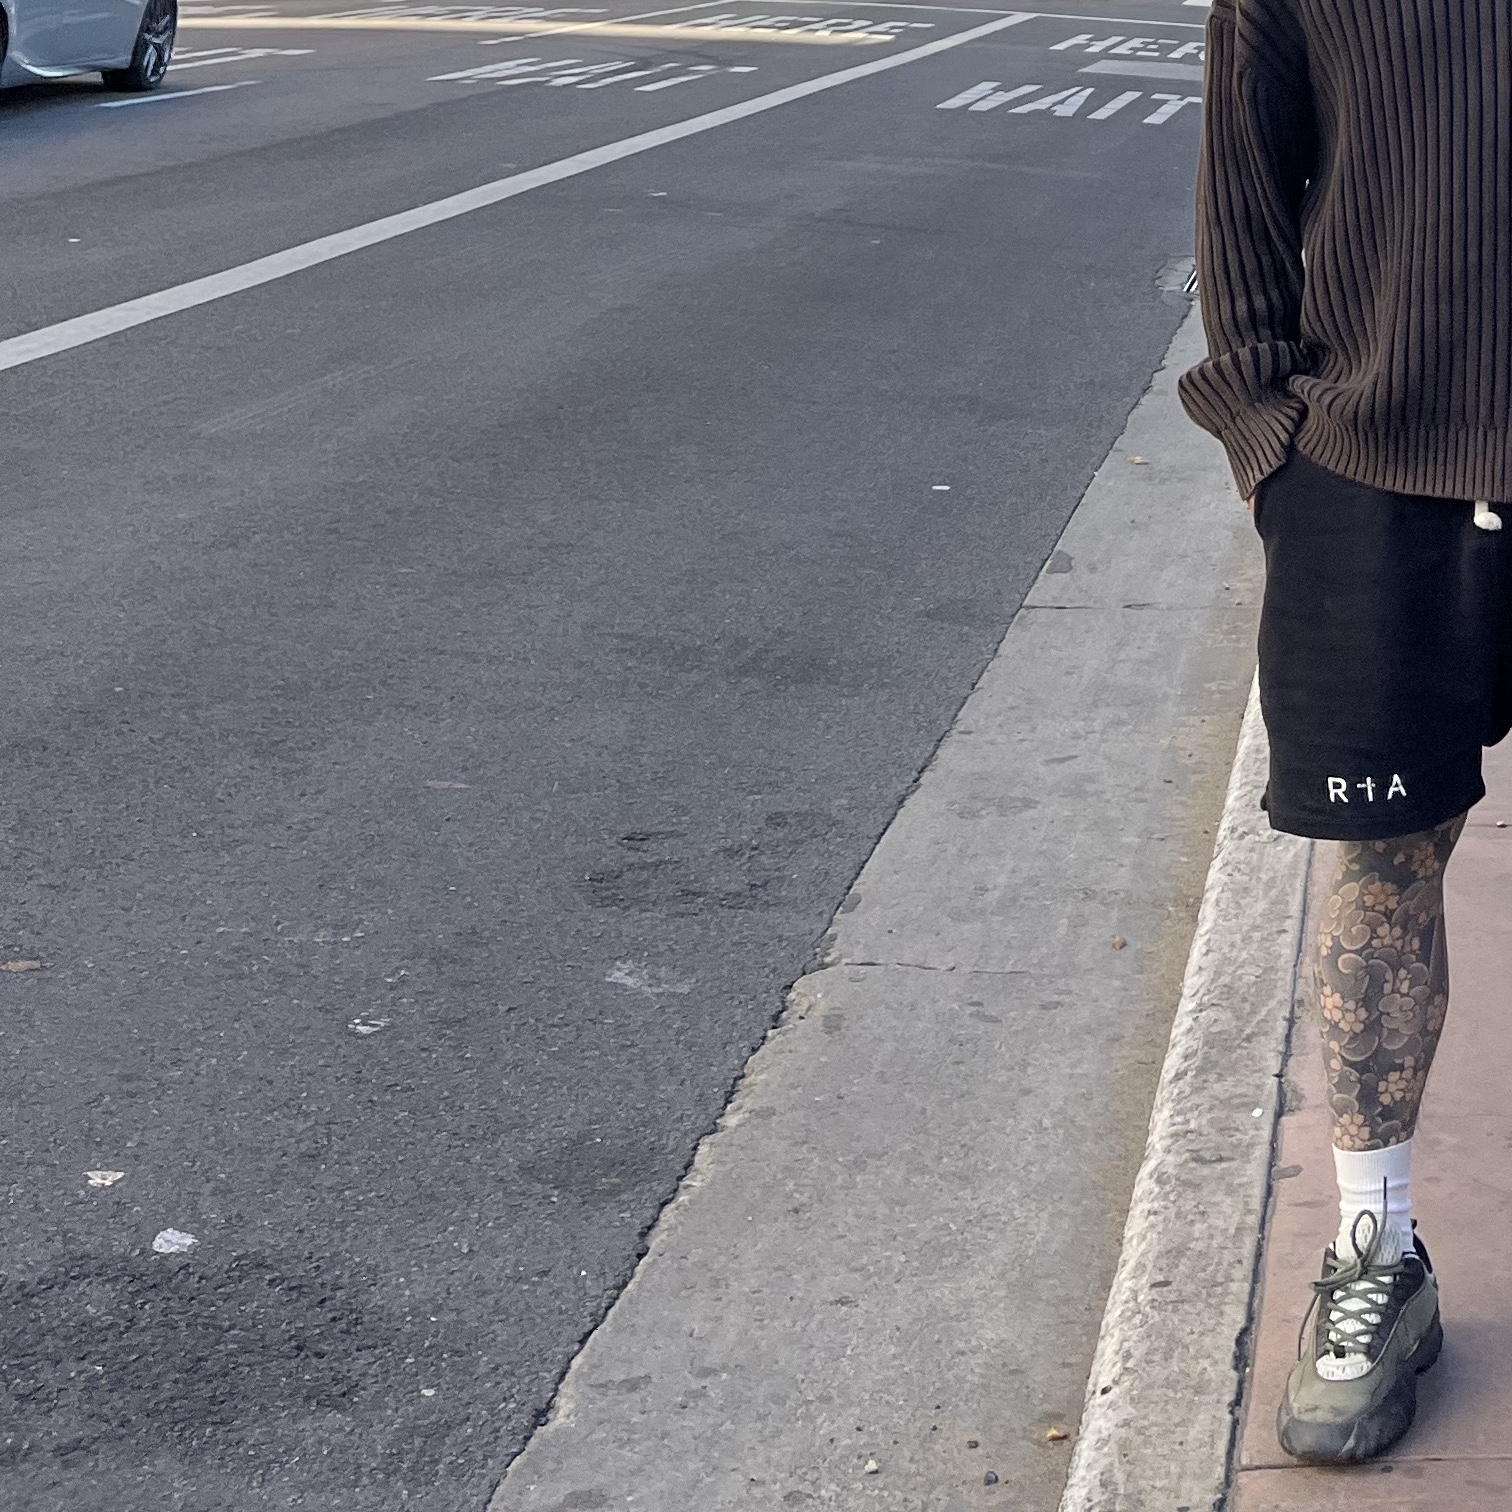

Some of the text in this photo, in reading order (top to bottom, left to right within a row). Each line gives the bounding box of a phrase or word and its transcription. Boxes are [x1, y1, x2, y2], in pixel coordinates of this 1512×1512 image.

[675, 13, 936, 39] HERE
[1048, 33, 1206, 60] HER
[934, 80, 1204, 125] WAIT
